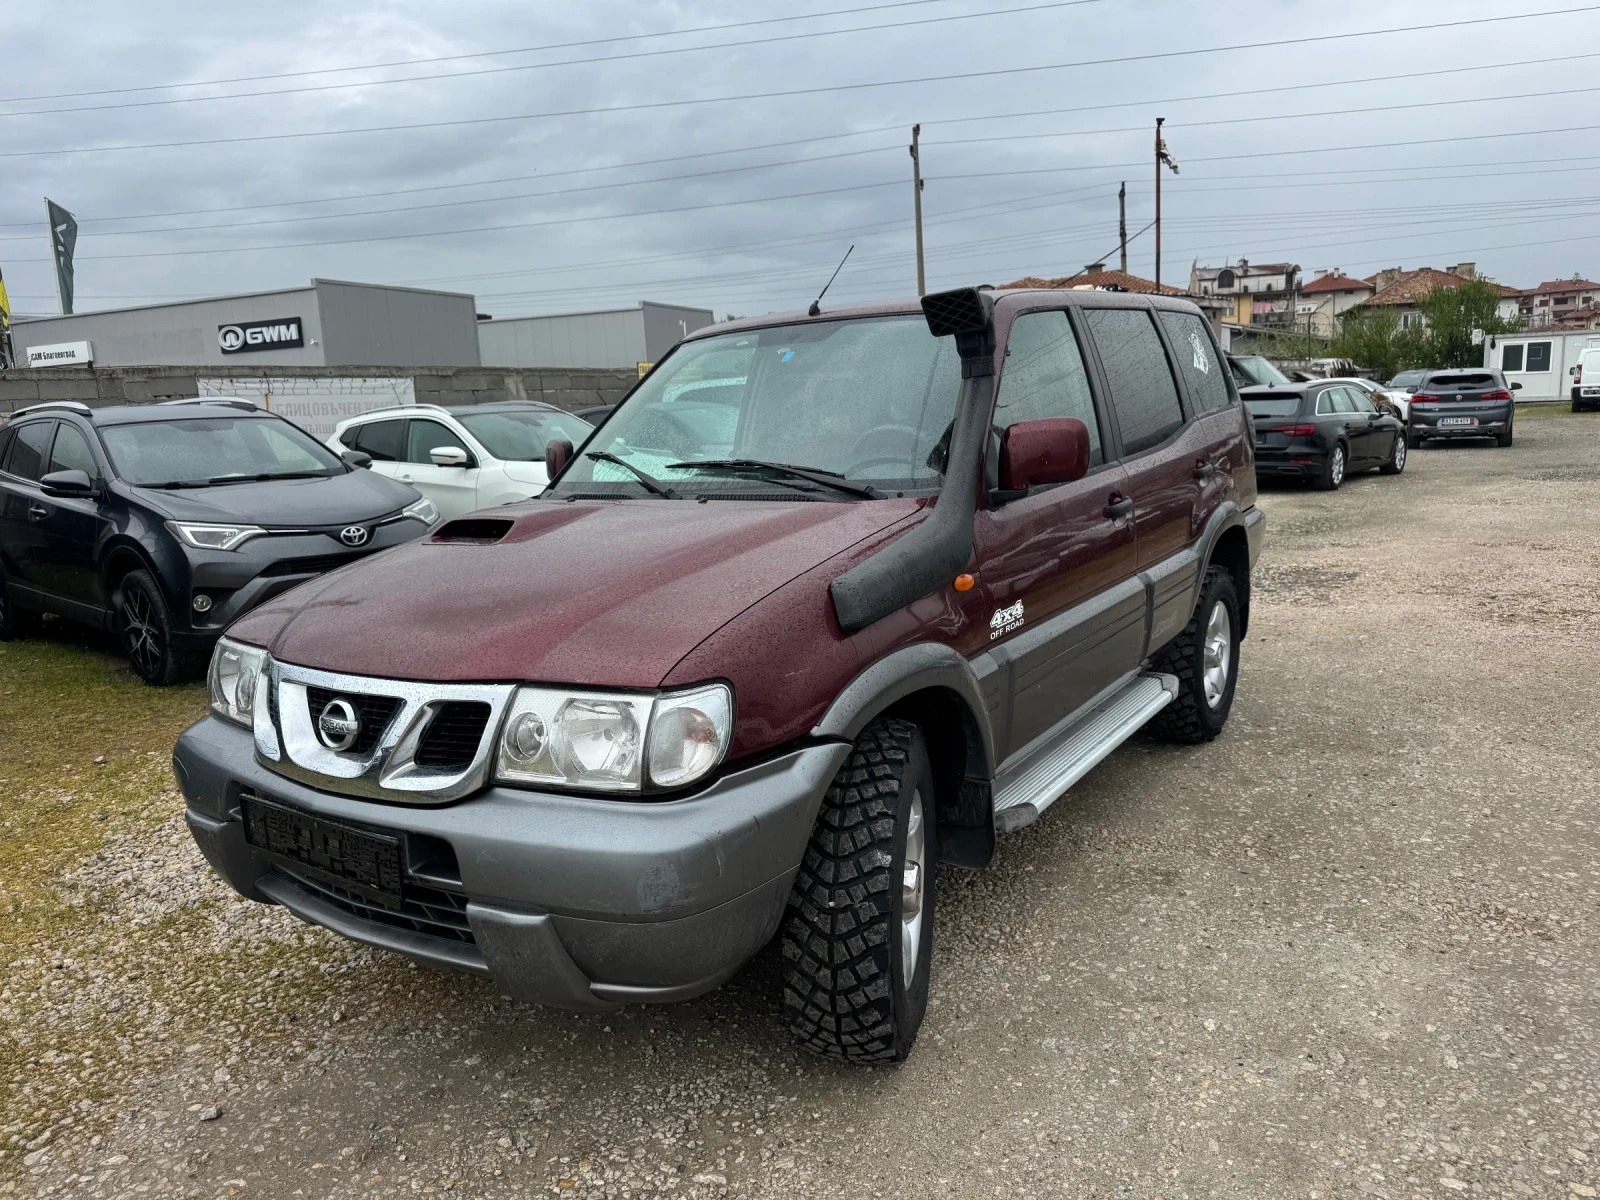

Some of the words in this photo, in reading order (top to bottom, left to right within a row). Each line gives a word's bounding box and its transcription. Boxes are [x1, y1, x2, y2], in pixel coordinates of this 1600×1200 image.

[245, 323, 299, 345] GWM
[43, 350, 76, 360] Благоевград
[990, 627, 1004, 640] OFF
[1005, 618, 1025, 633] ROAD
